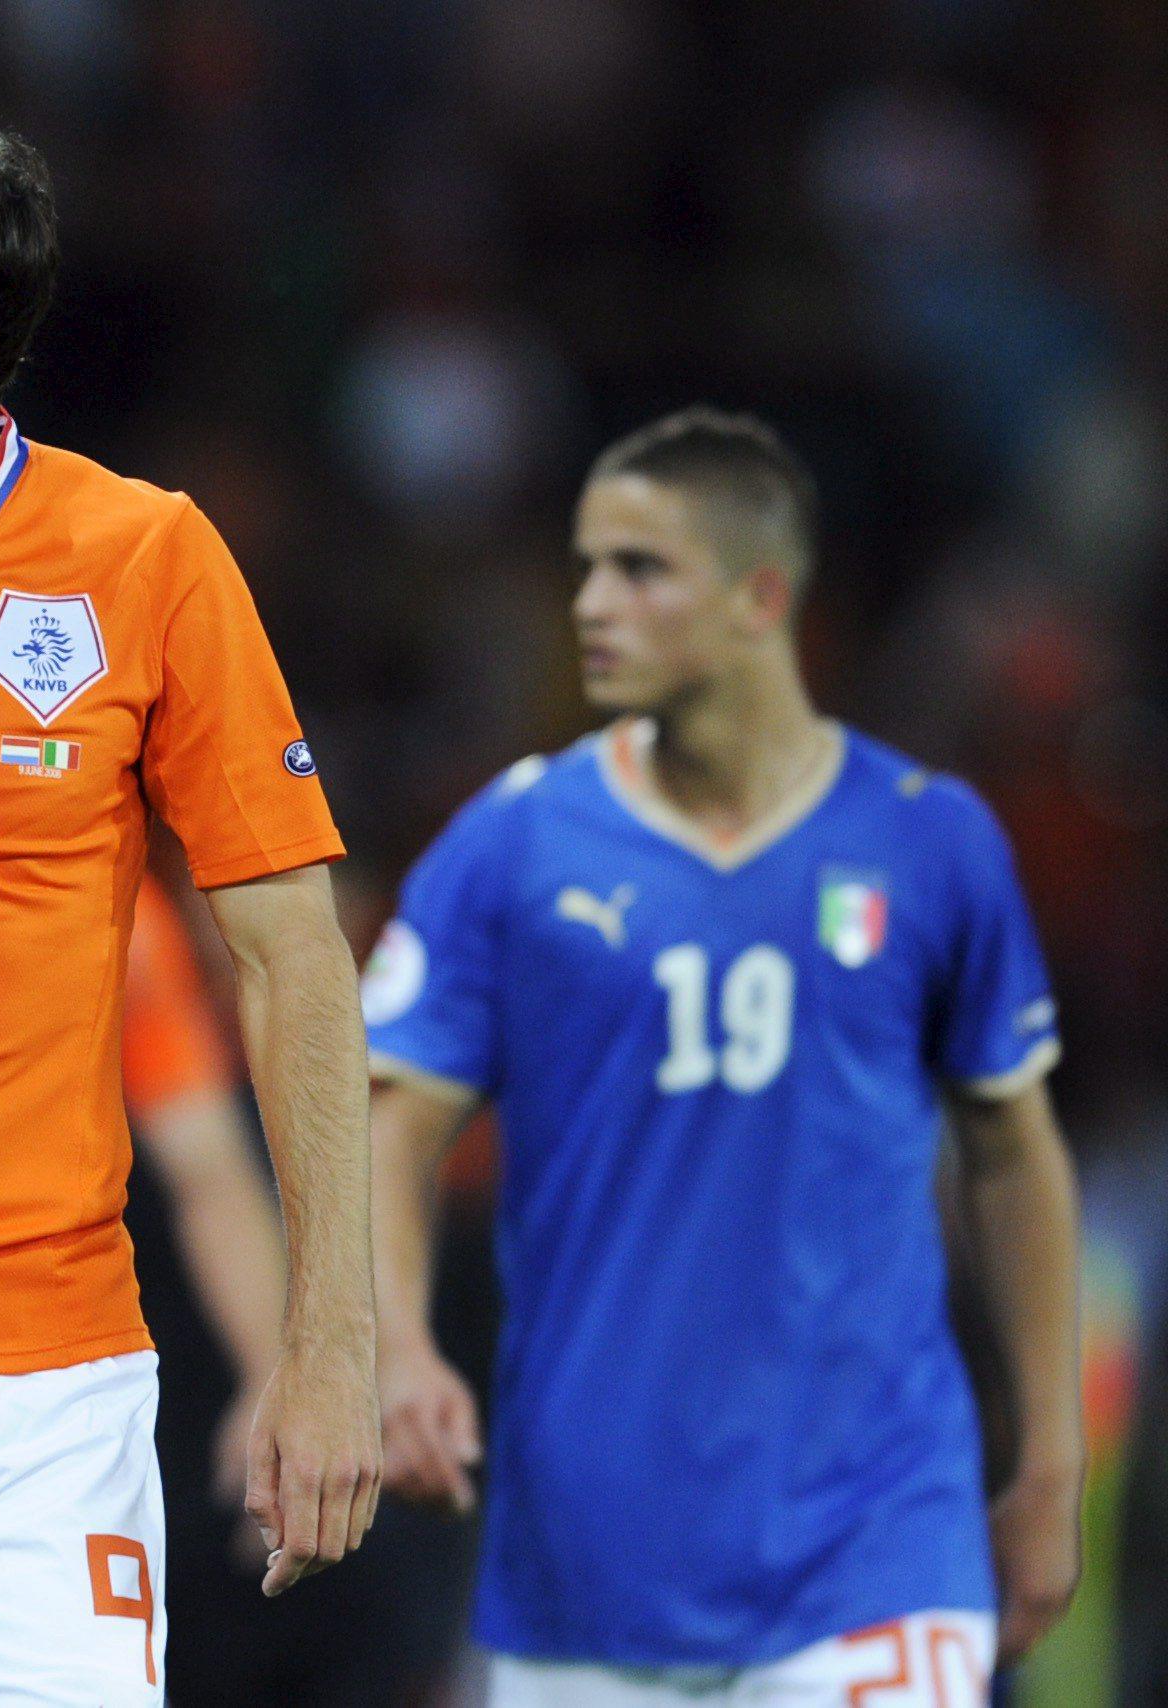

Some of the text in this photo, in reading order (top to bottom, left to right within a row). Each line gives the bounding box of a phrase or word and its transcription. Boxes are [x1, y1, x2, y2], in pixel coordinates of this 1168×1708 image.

[23, 678, 67, 692] KNVB
[654, 944, 794, 1092] 19
[85, 1534, 157, 1687] 9
